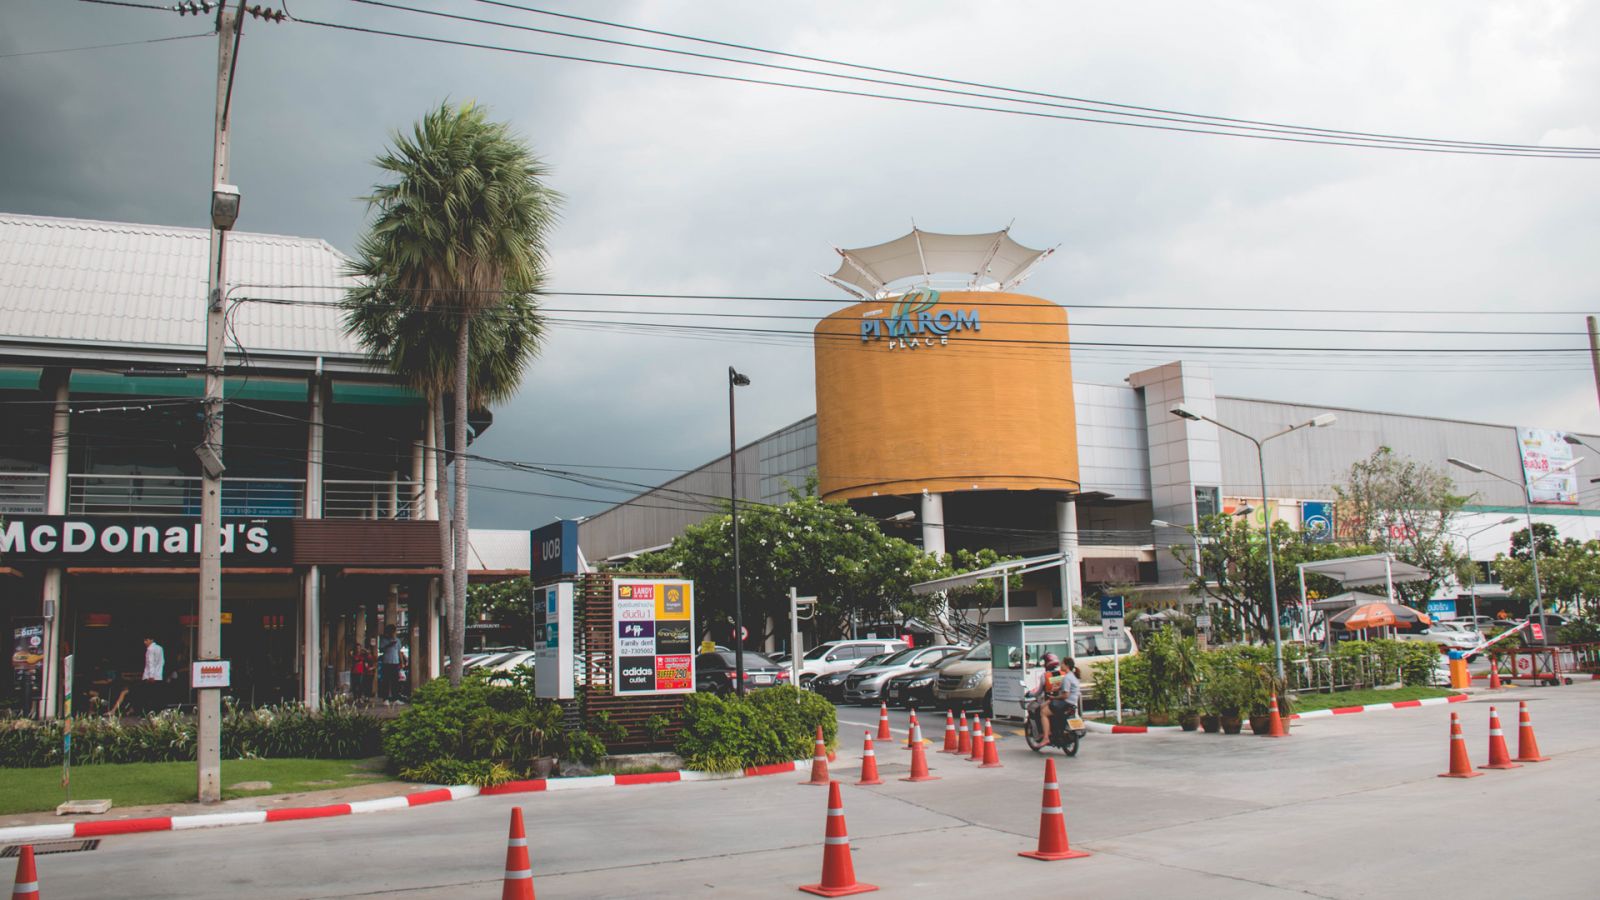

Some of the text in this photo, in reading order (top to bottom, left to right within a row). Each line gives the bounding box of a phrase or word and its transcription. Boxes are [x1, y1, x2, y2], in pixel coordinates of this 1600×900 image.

[861, 310, 980, 343] PIYAROM
[889, 336, 948, 350] PLACE
[0, 521, 269, 554] McDonald's
[542, 538, 561, 560] UOB
[622, 667, 653, 676] adidas
